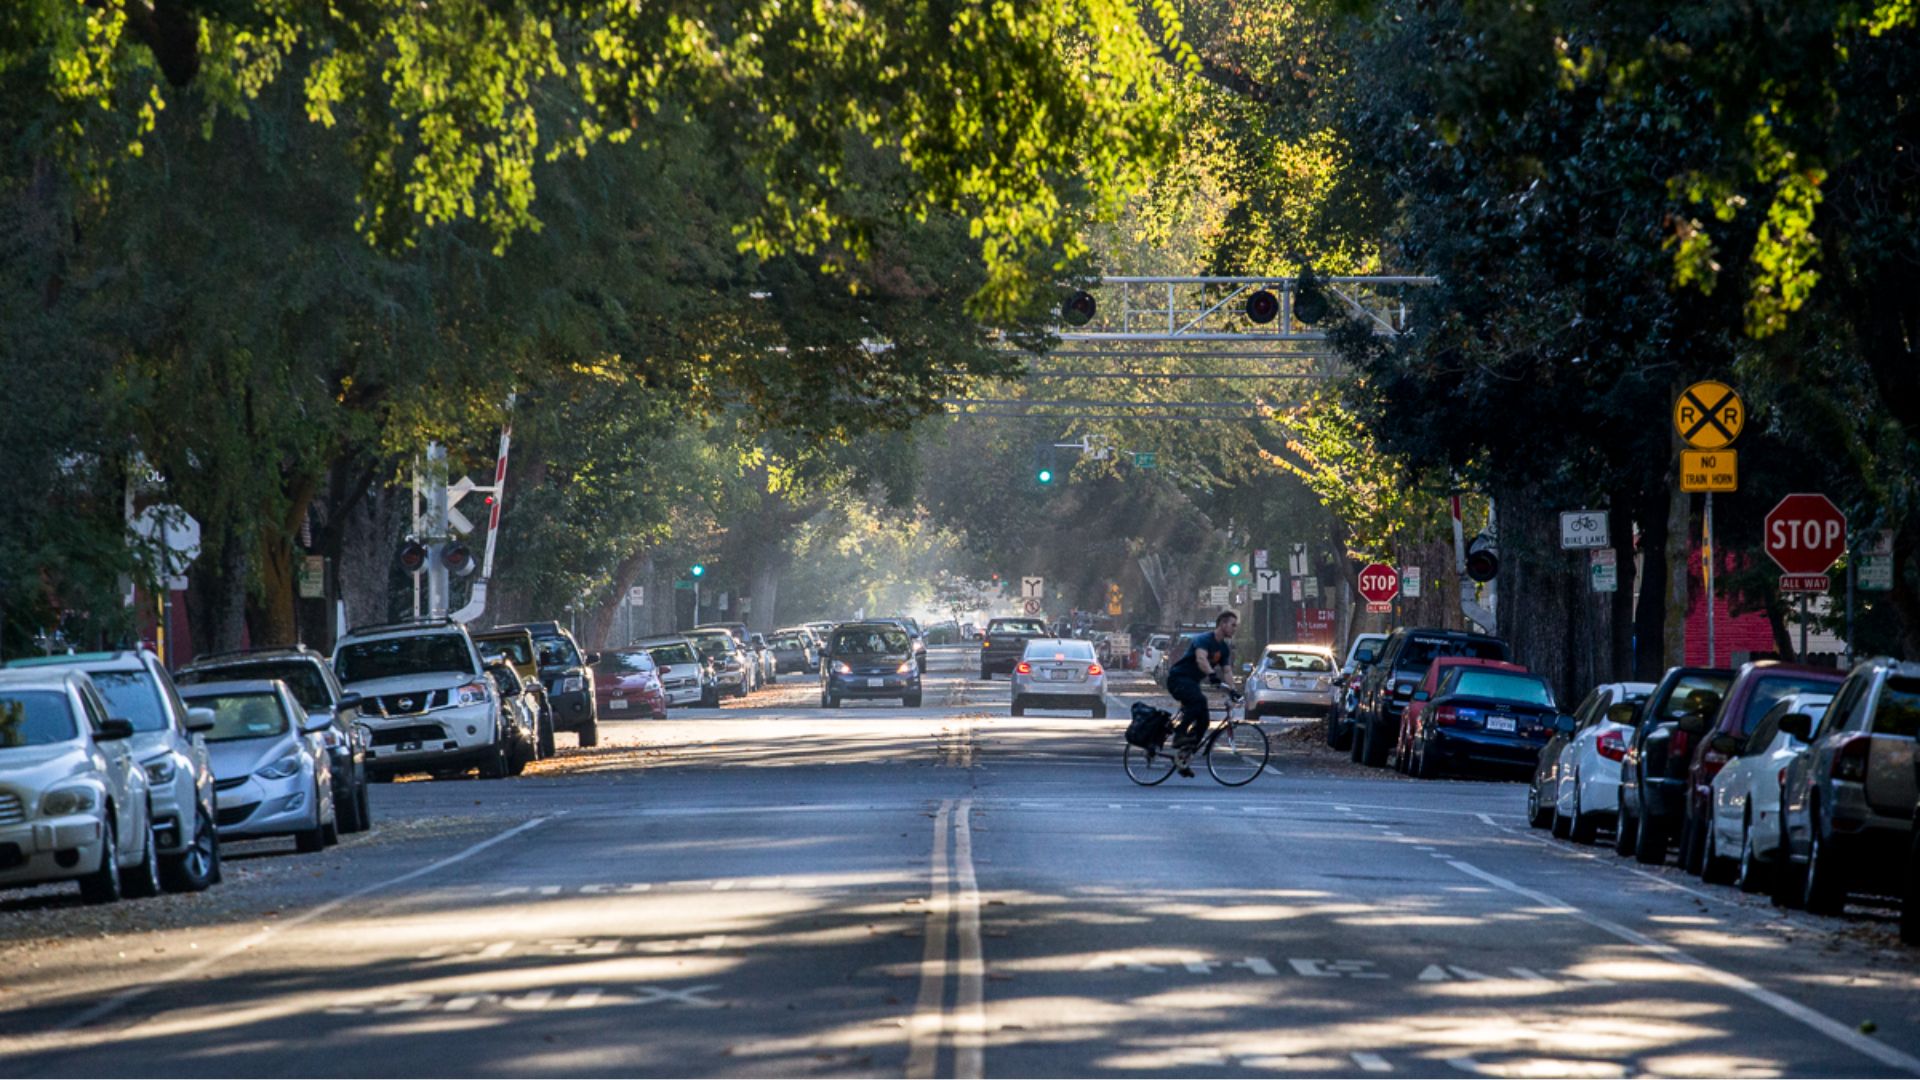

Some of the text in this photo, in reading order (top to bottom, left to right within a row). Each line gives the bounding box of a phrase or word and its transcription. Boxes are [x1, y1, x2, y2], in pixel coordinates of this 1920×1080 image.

[1701, 456, 1716, 468] NO
[1685, 473, 1733, 484] TRAIN HORN
[1771, 519, 1840, 549] STOP
[1564, 536, 1606, 545] BIKE LANE
[1362, 575, 1396, 591] STOP
[1783, 578, 1827, 588] ALL WAY
